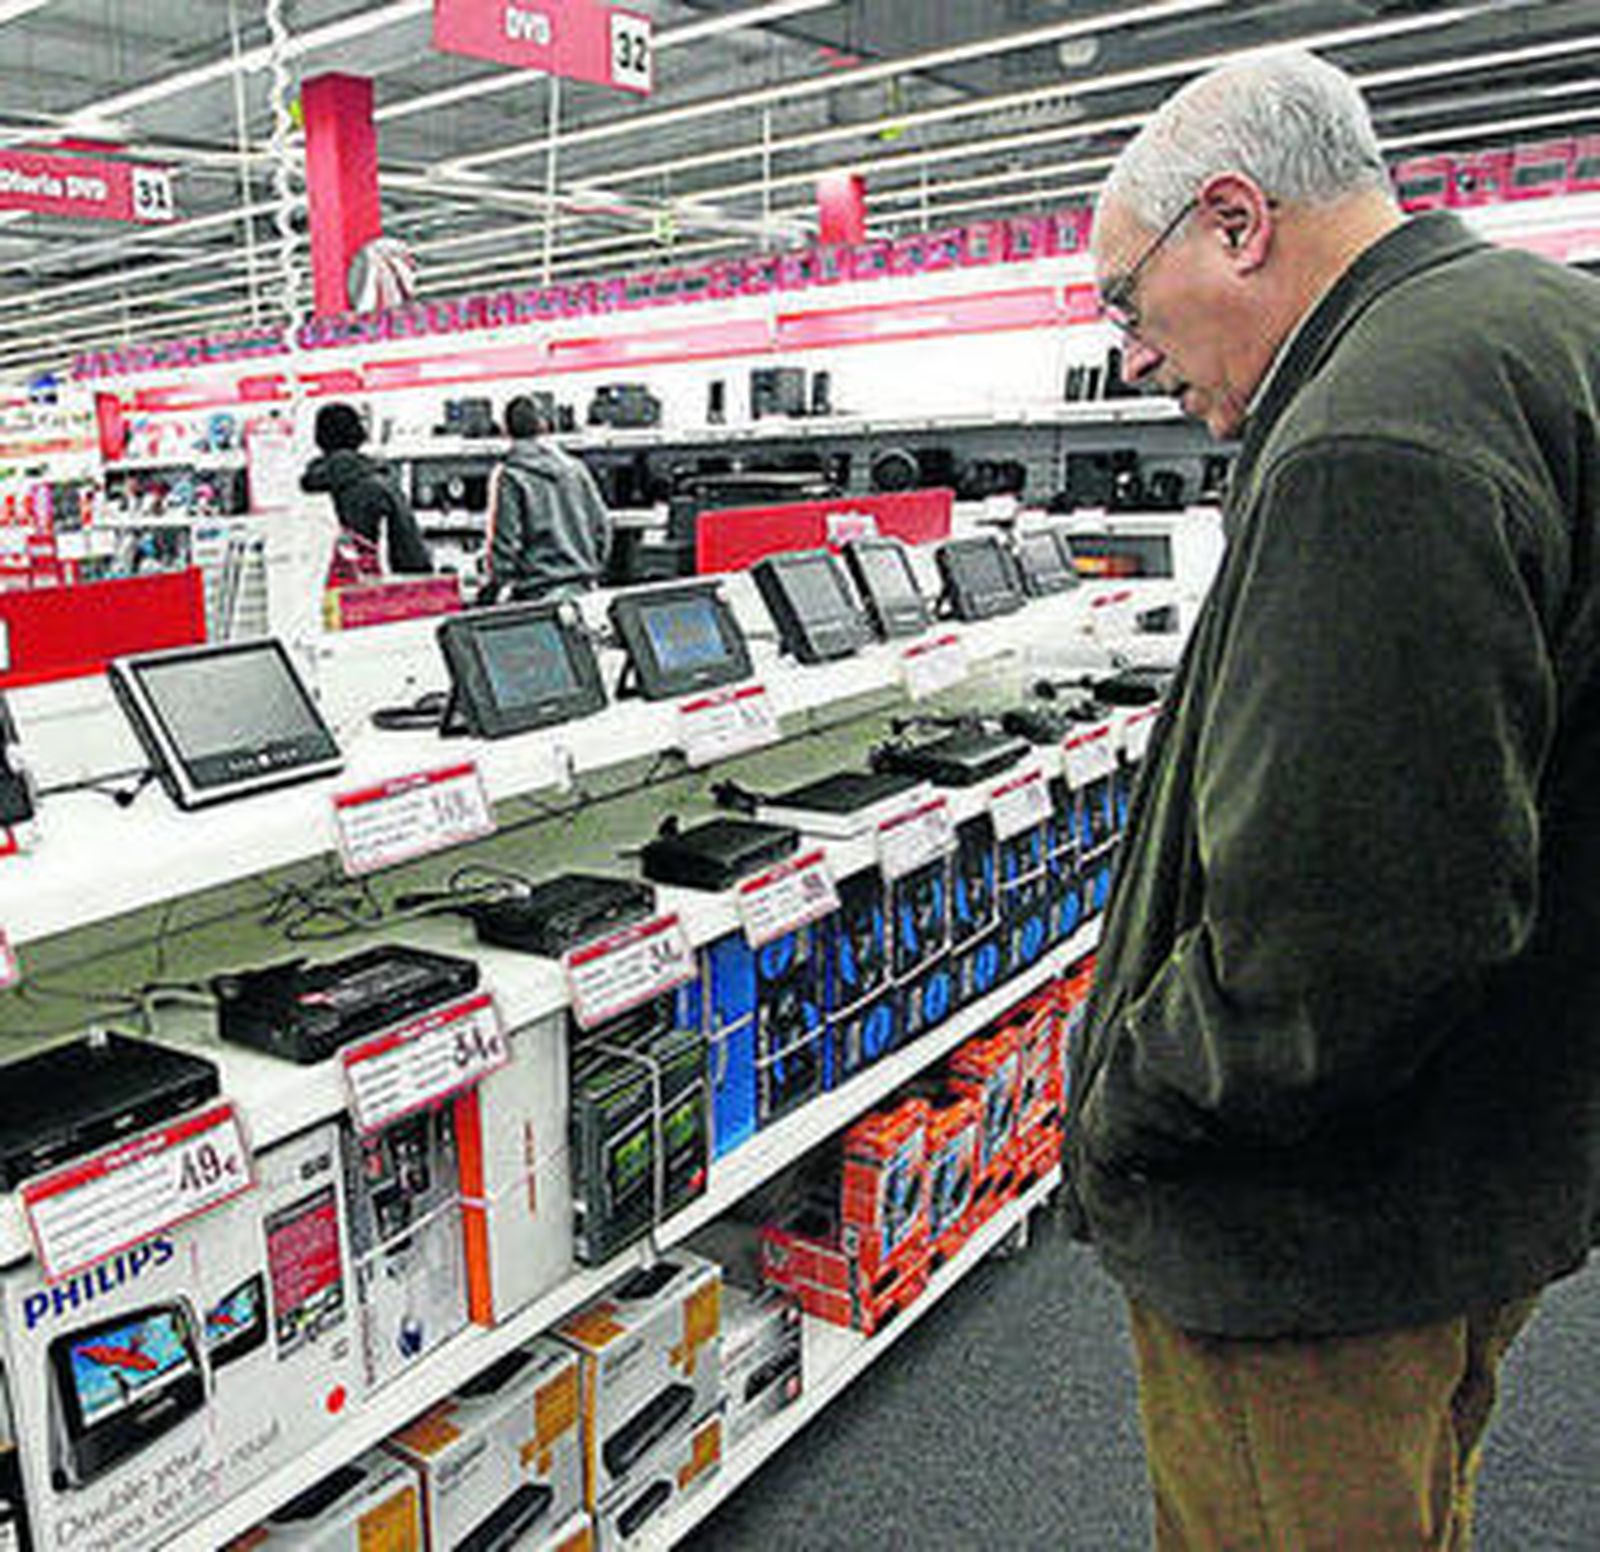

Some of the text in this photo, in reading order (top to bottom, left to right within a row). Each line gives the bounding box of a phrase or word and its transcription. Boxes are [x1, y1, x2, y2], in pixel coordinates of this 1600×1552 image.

[504, 6, 551, 47] DVD
[616, 31, 647, 74] 32
[137, 179, 166, 209] 31
[23, 1236, 175, 1330] PHILIPS
